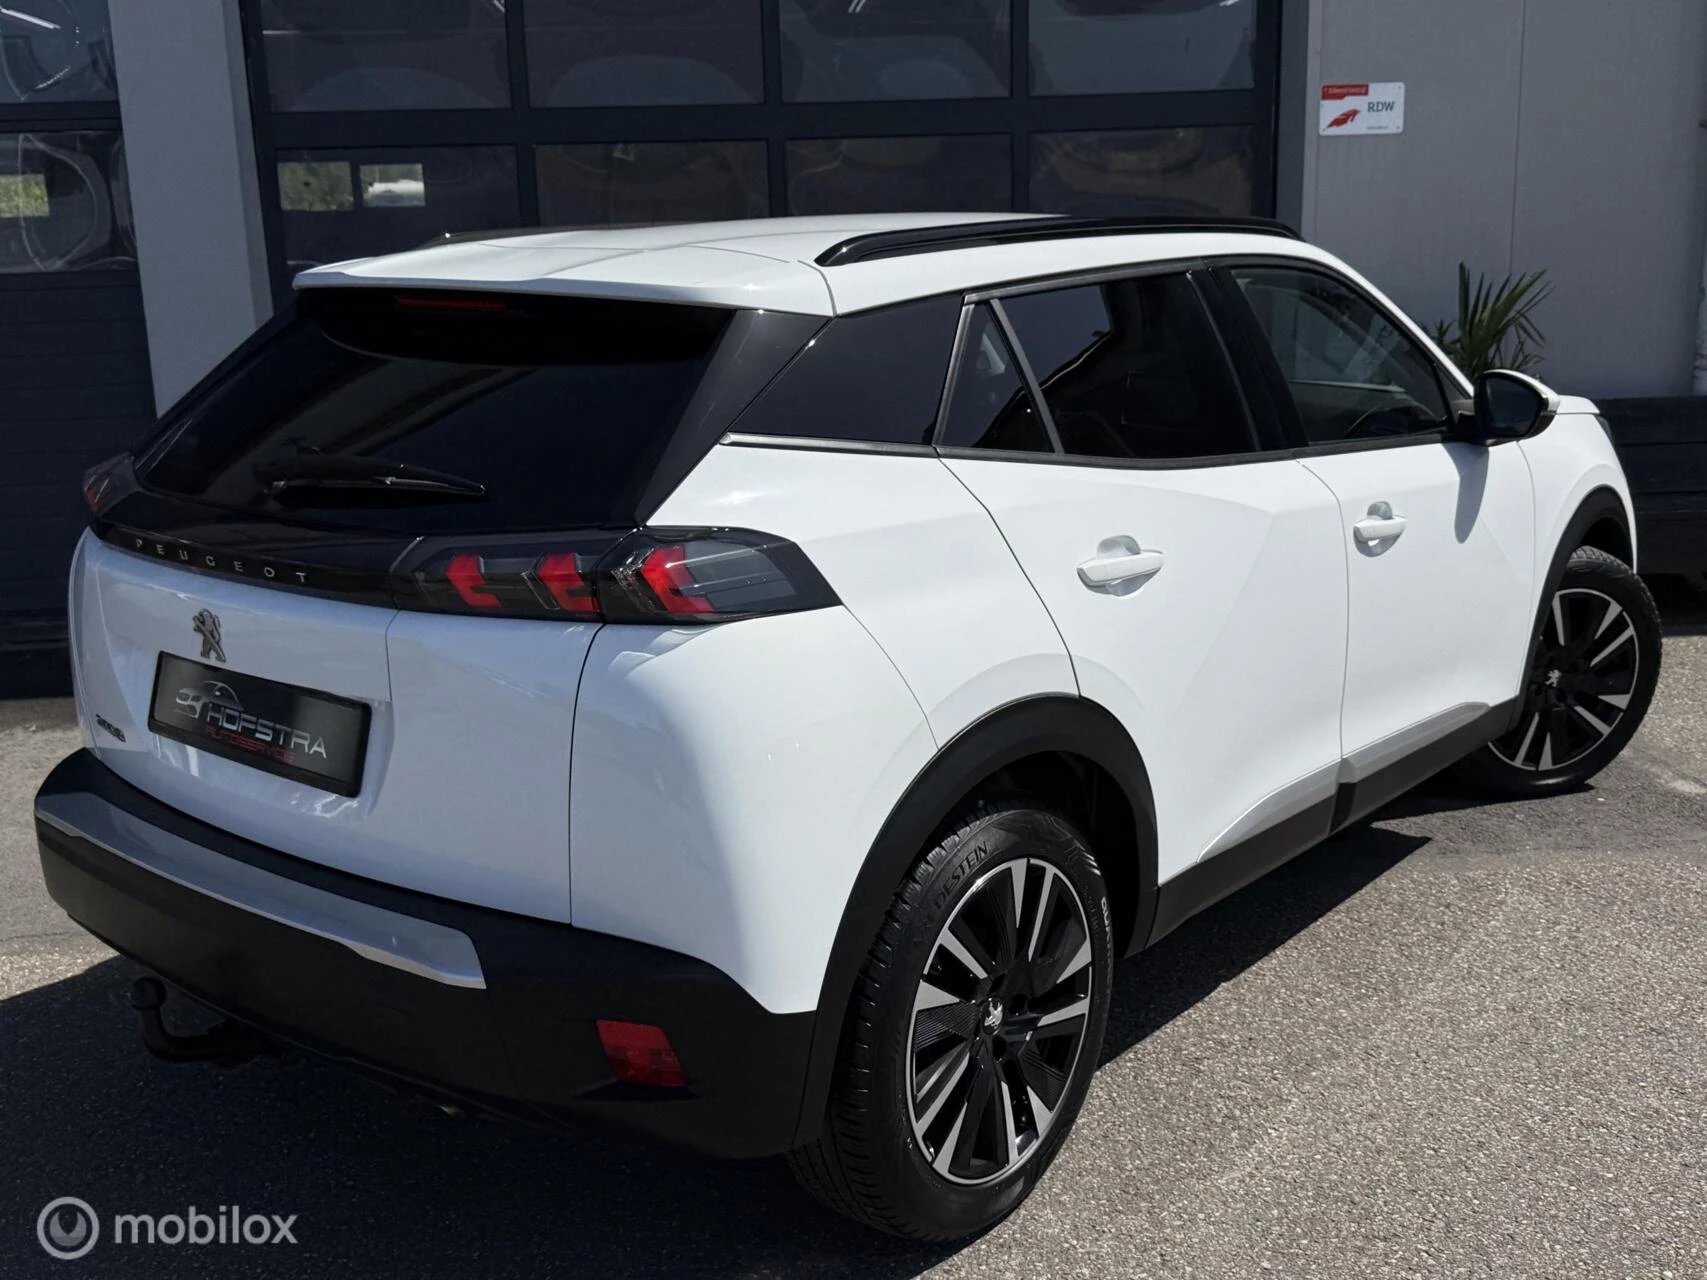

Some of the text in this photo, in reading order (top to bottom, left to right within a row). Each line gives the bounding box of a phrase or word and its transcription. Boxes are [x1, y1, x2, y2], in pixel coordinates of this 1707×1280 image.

[1367, 101, 1395, 113] RDW
[136, 538, 307, 583] PEUGEOT
[206, 703, 328, 760] HOFSTRA
